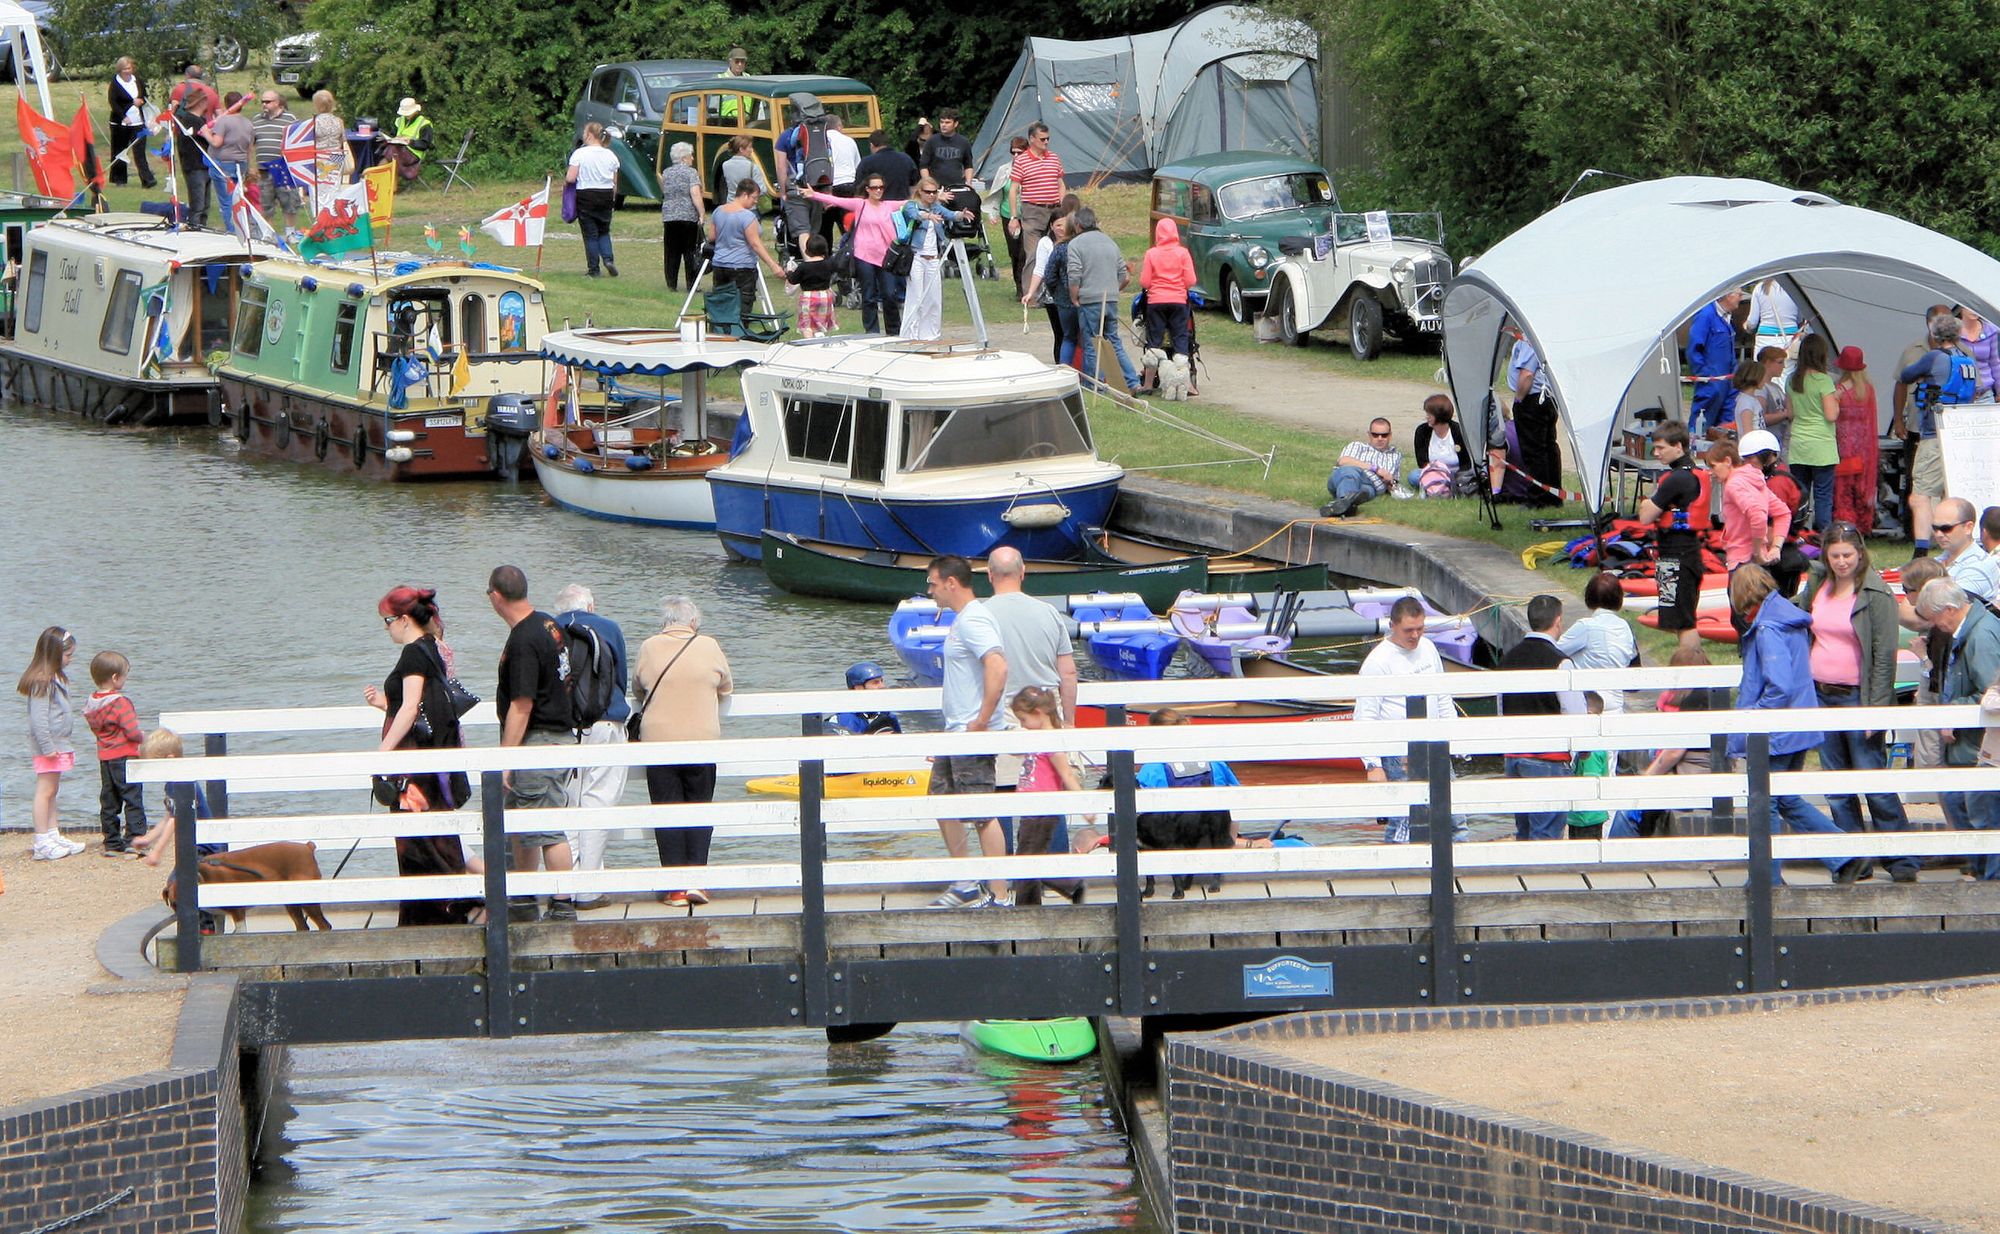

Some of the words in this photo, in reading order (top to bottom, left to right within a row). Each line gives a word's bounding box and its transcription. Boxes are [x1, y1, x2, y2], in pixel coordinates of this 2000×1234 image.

[60, 257, 80, 281] Toad
[62, 289, 82, 315] Hall
[497, 405, 518, 414] YAMAHA
[1128, 565, 1180, 576] DISCOVERY
[863, 776, 904, 787] liquidlogic
[1266, 960, 1301, 974] SUPPORTED
